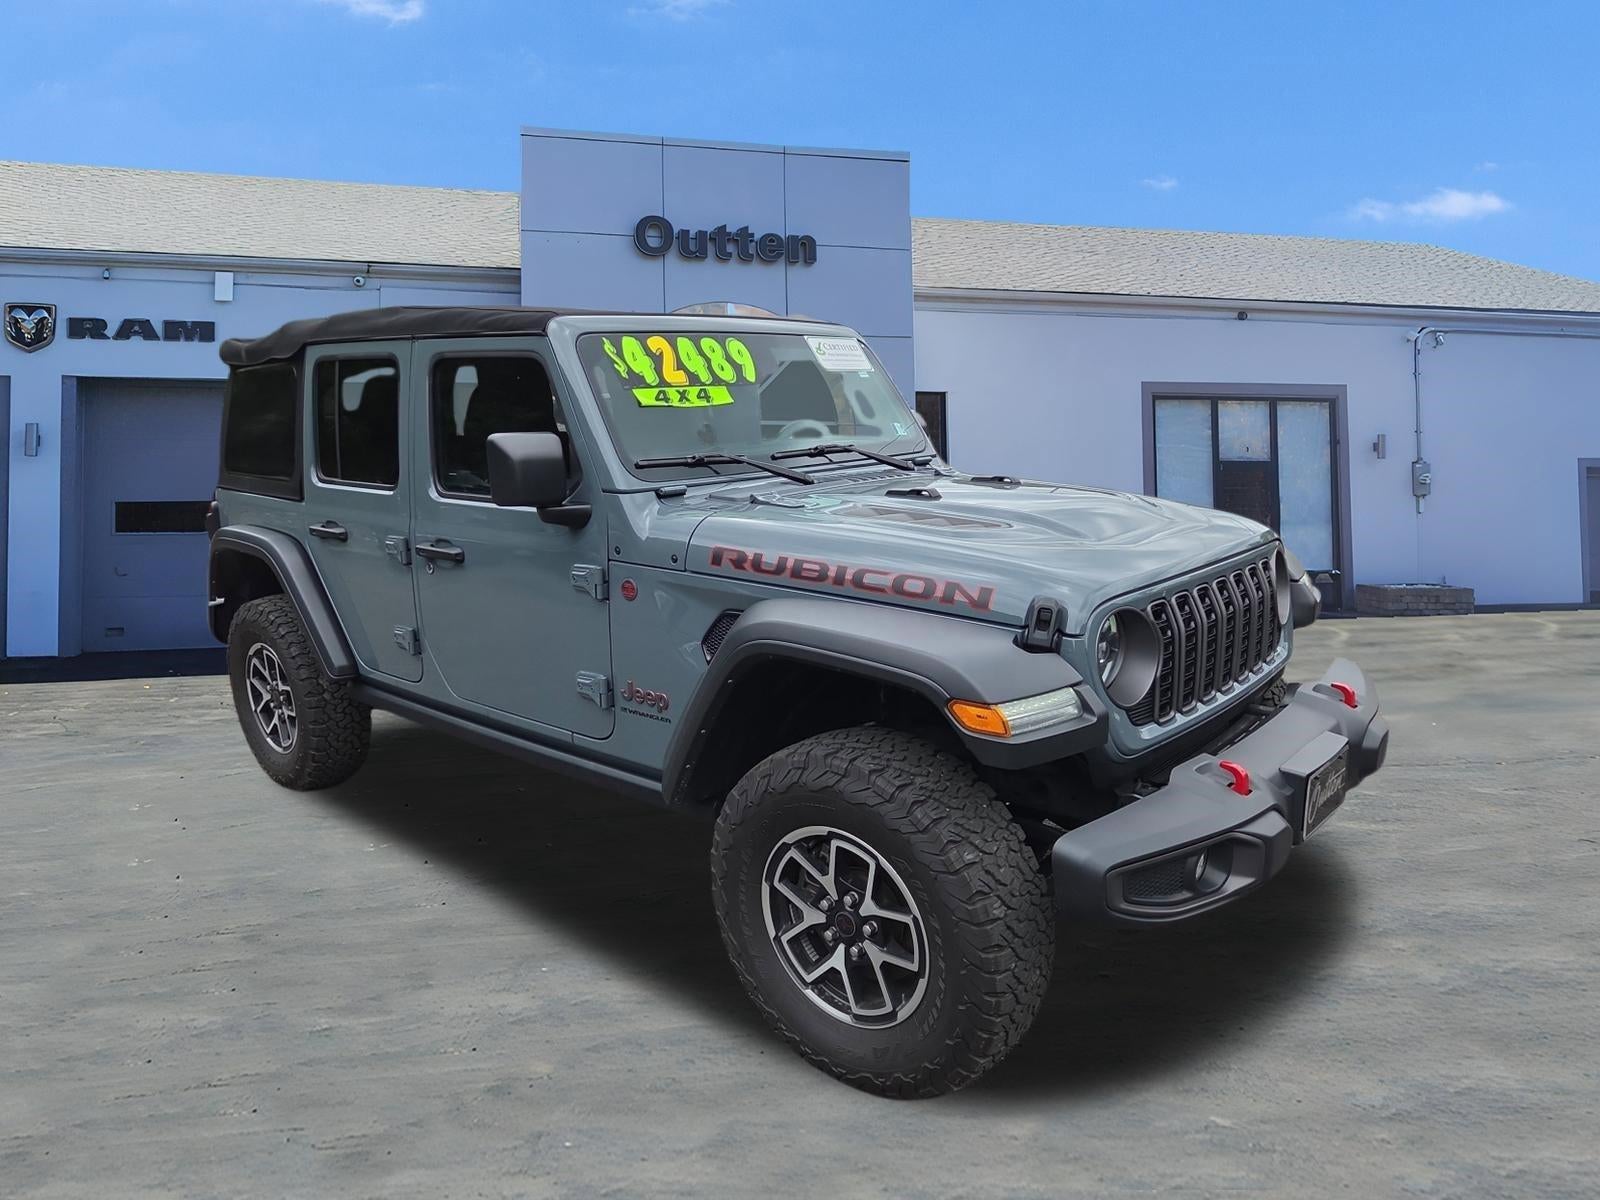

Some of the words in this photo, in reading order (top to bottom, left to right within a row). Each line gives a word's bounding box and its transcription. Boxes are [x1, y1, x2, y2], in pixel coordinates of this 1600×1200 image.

[634, 215, 817, 264] Outten
[66, 317, 216, 343] RAM
[602, 335, 757, 386] $42489
[710, 545, 995, 613] RUBICON
[620, 679, 669, 714] Jeep
[628, 708, 672, 724] WRANGLER
